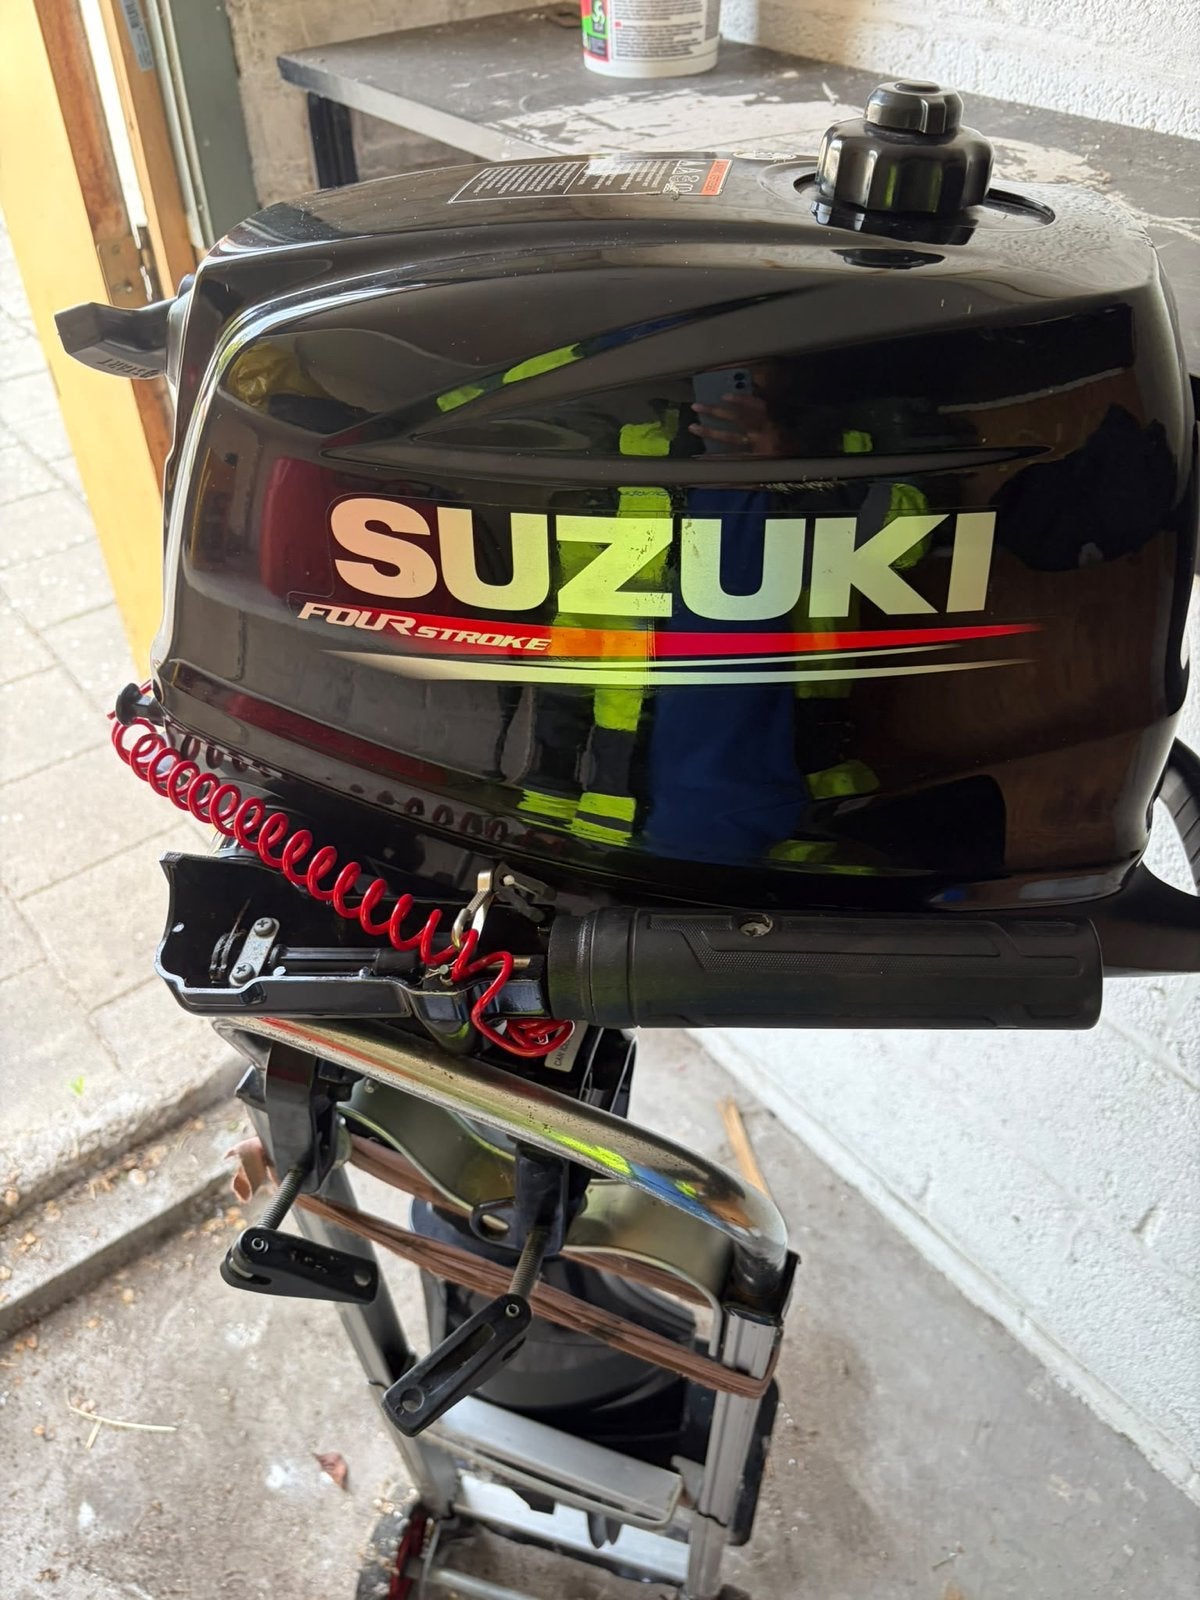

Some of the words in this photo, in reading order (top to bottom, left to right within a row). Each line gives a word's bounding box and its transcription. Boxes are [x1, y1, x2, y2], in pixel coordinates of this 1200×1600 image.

[331, 498, 997, 620] SUZUKI
[297, 602, 416, 636] FOUR
[414, 626, 553, 651] STROKE
